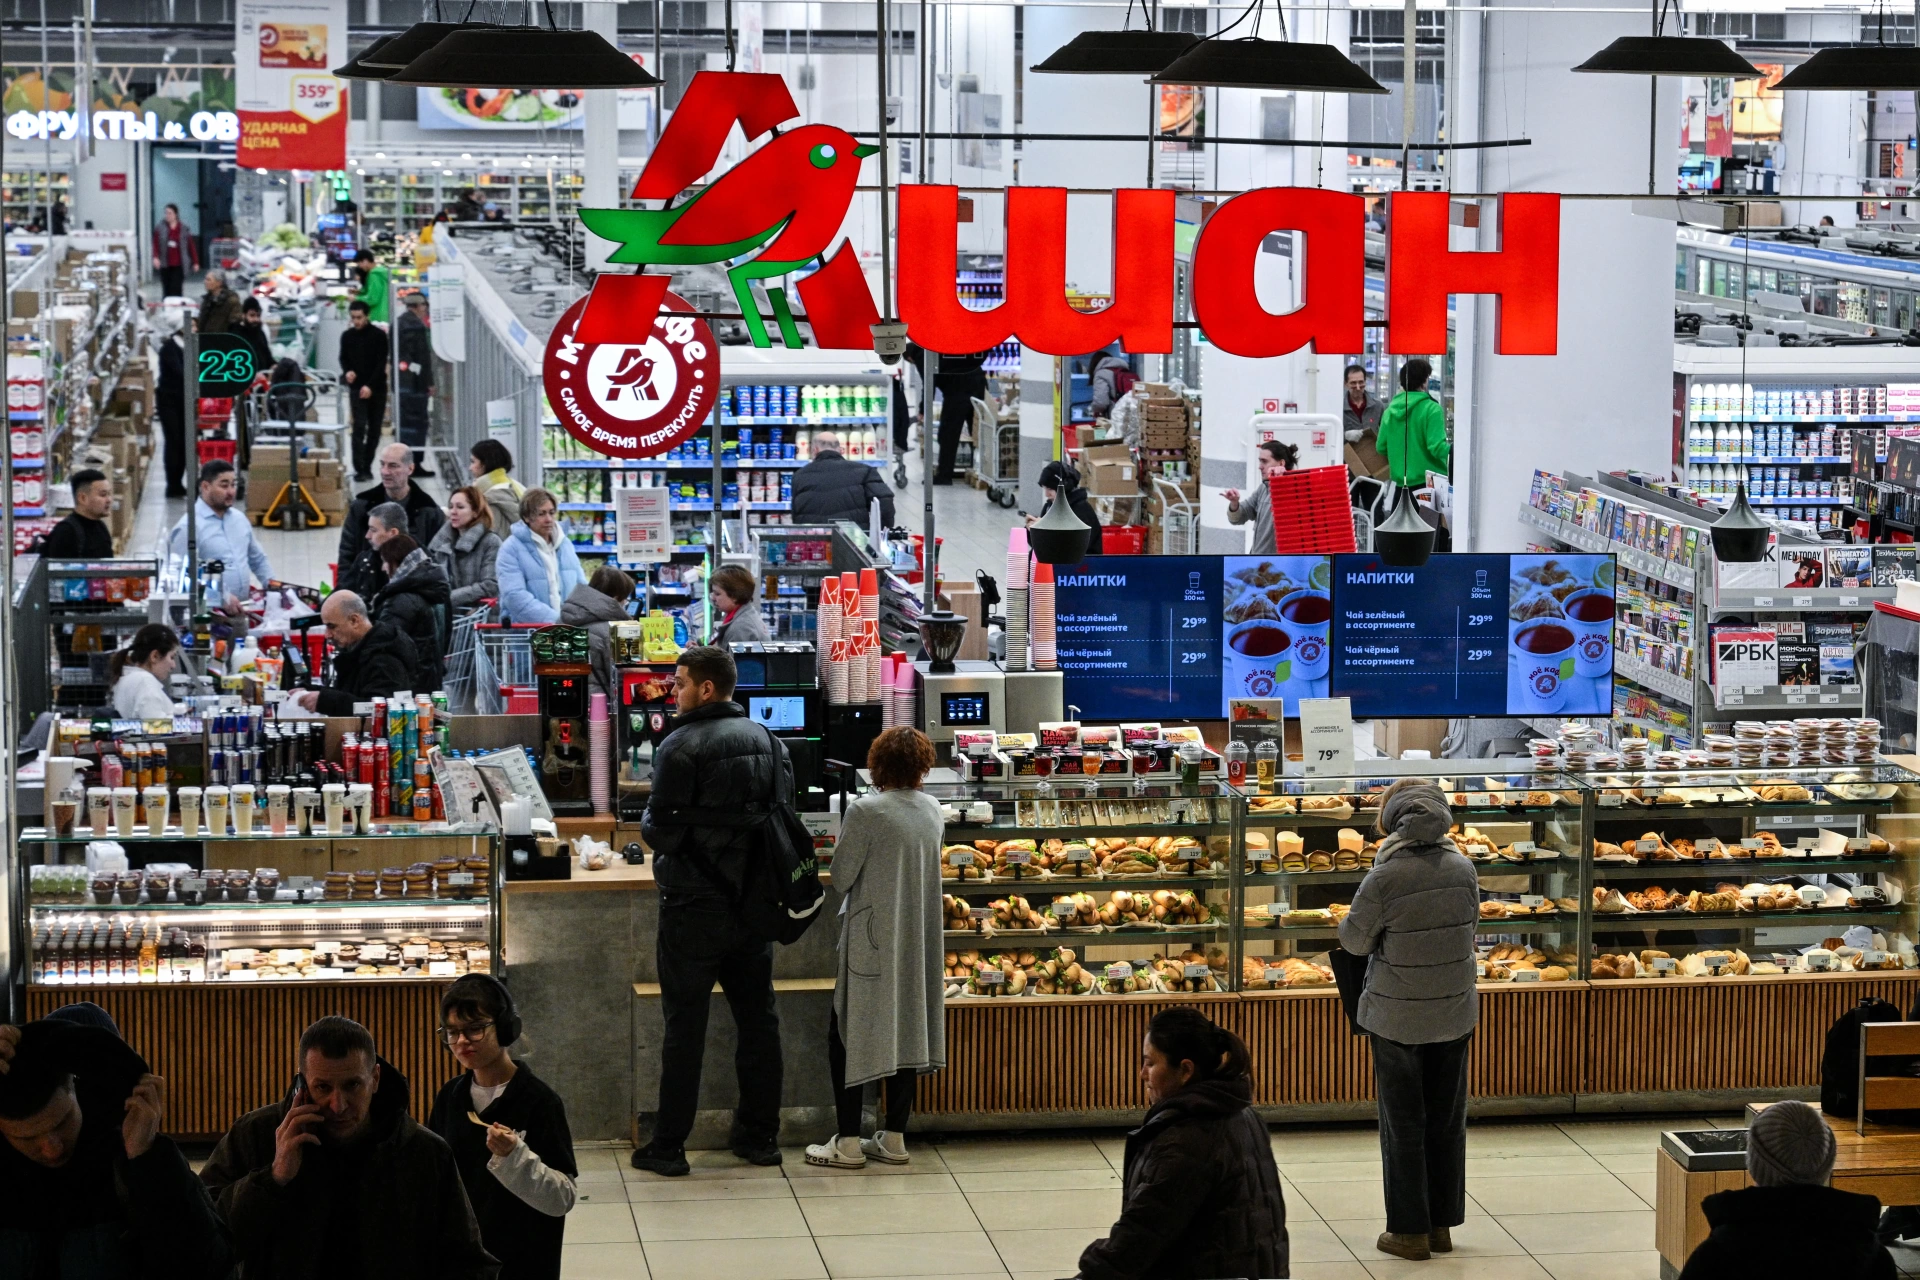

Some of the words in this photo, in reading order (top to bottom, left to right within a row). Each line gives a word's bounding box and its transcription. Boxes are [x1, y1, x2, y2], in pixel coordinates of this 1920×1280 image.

[163, 120, 187, 139] и
[243, 121, 307, 135] УДАРНАЯ
[243, 136, 281, 149] ЦЕНА
[1090, 298, 1107, 308] 60
[199, 349, 255, 383] 23
[560, 387, 594, 432] САМОЕ
[591, 426, 638, 449] ВРЕМЯ
[640, 385, 704, 448] ПЕРЕКУСИТЬ
[1781, 551, 1797, 560] MEN
[1799, 551, 1821, 560] TODAY
[1876, 549, 1915, 557] ТехИнсайдер
[1057, 575, 1127, 587] НАПИТКИ
[1346, 572, 1415, 584] НАПИТКИ
[1057, 613, 1075, 622] Чай
[1076, 613, 1118, 622] зелёный
[1345, 611, 1363, 619] Чай
[1365, 610, 1406, 619] зелёный
[1064, 625, 1128, 633] ассортименте
[1352, 622, 1416, 631] ассортименте
[1057, 648, 1075, 657] Чай
[1076, 648, 1112, 658] чёрный
[1345, 645, 1363, 654] Чай
[1364, 645, 1400, 655] чёрный
[1736, 643, 1776, 661] РБК
[1064, 661, 1128, 670] ассортименте
[1352, 658, 1415, 667] ассортименте
[1244, 668, 1258, 684] моё
[1260, 668, 1277, 682] каф
[1528, 667, 1543, 681] моё
[1544, 667, 1561, 679] каф
[562, 679, 573, 687] 96
[800, 858, 815, 870] Air
[805, 1153, 829, 1164] crocs
